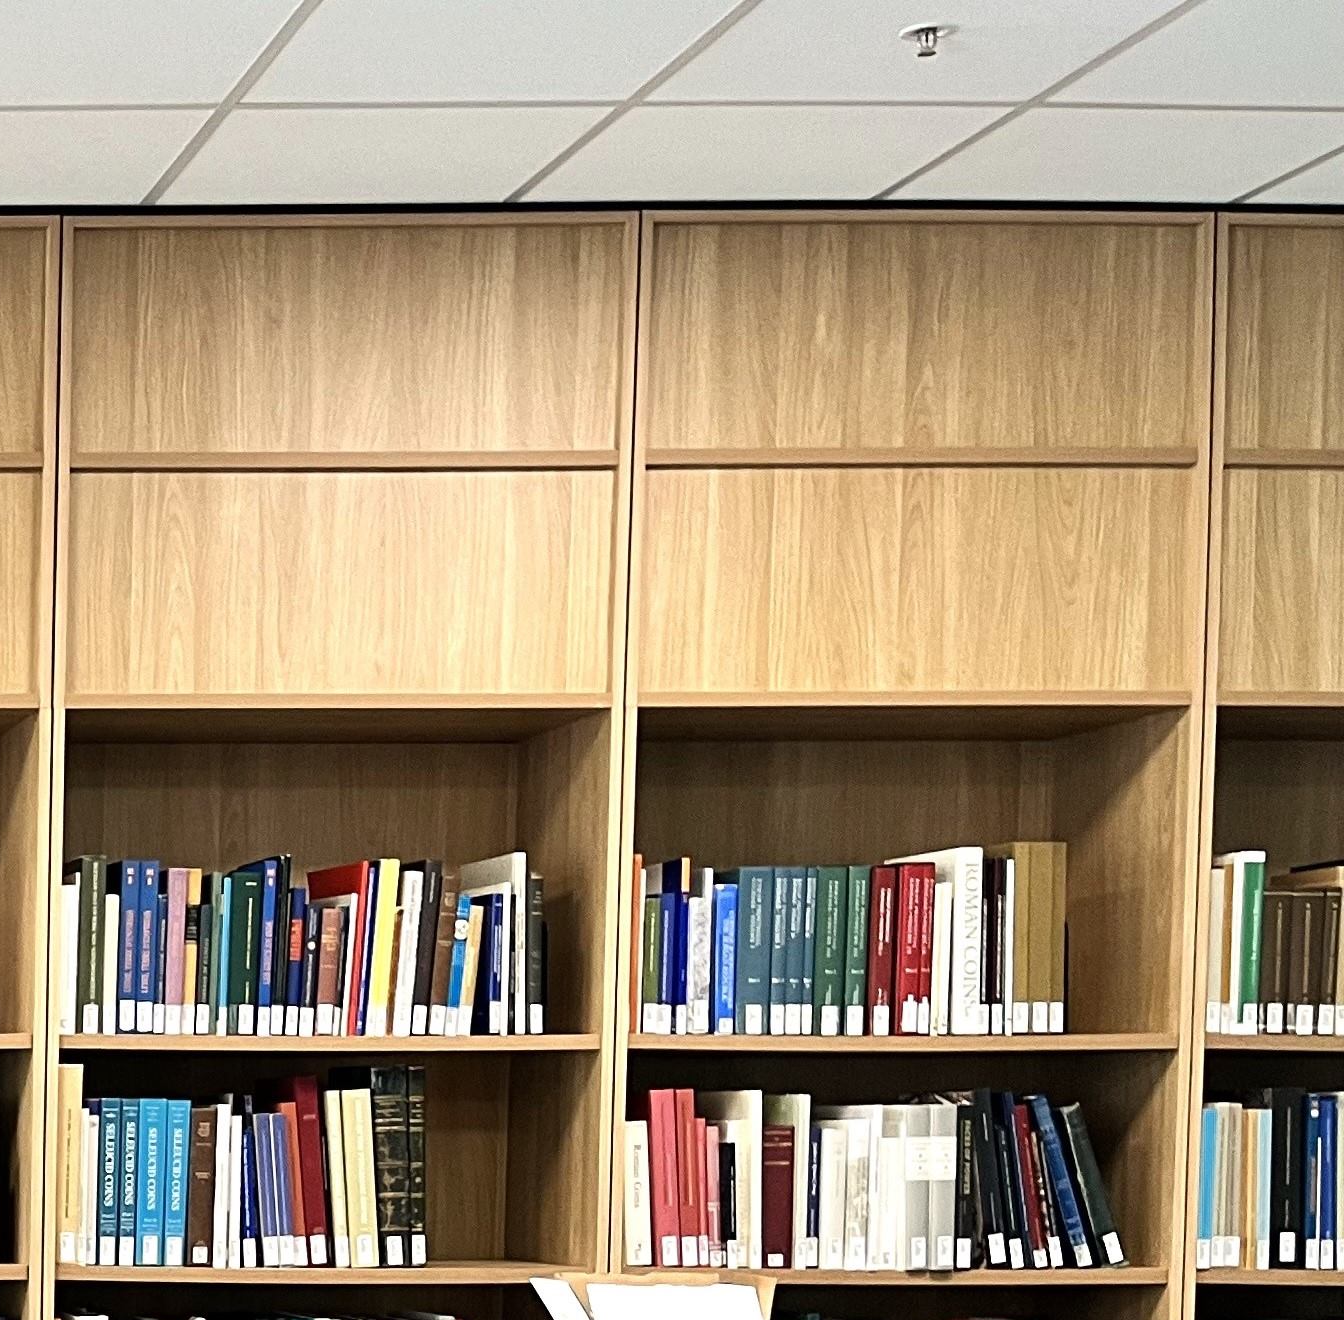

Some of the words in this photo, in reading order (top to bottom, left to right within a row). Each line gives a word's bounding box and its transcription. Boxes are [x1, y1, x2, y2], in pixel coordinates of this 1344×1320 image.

[965, 863, 980, 939] ROMAN
[105, 1123, 116, 1174] SELEUCID
[124, 1121, 135, 1173] SELEUCID
[148, 1127, 158, 1178] SELEUCID
[173, 1128, 183, 1178] SELEUCID
[103, 1175, 114, 1207] COINS
[123, 1174, 134, 1206] COINS
[146, 1179, 156, 1211] COINS
[171, 1180, 181, 1211] COINS
